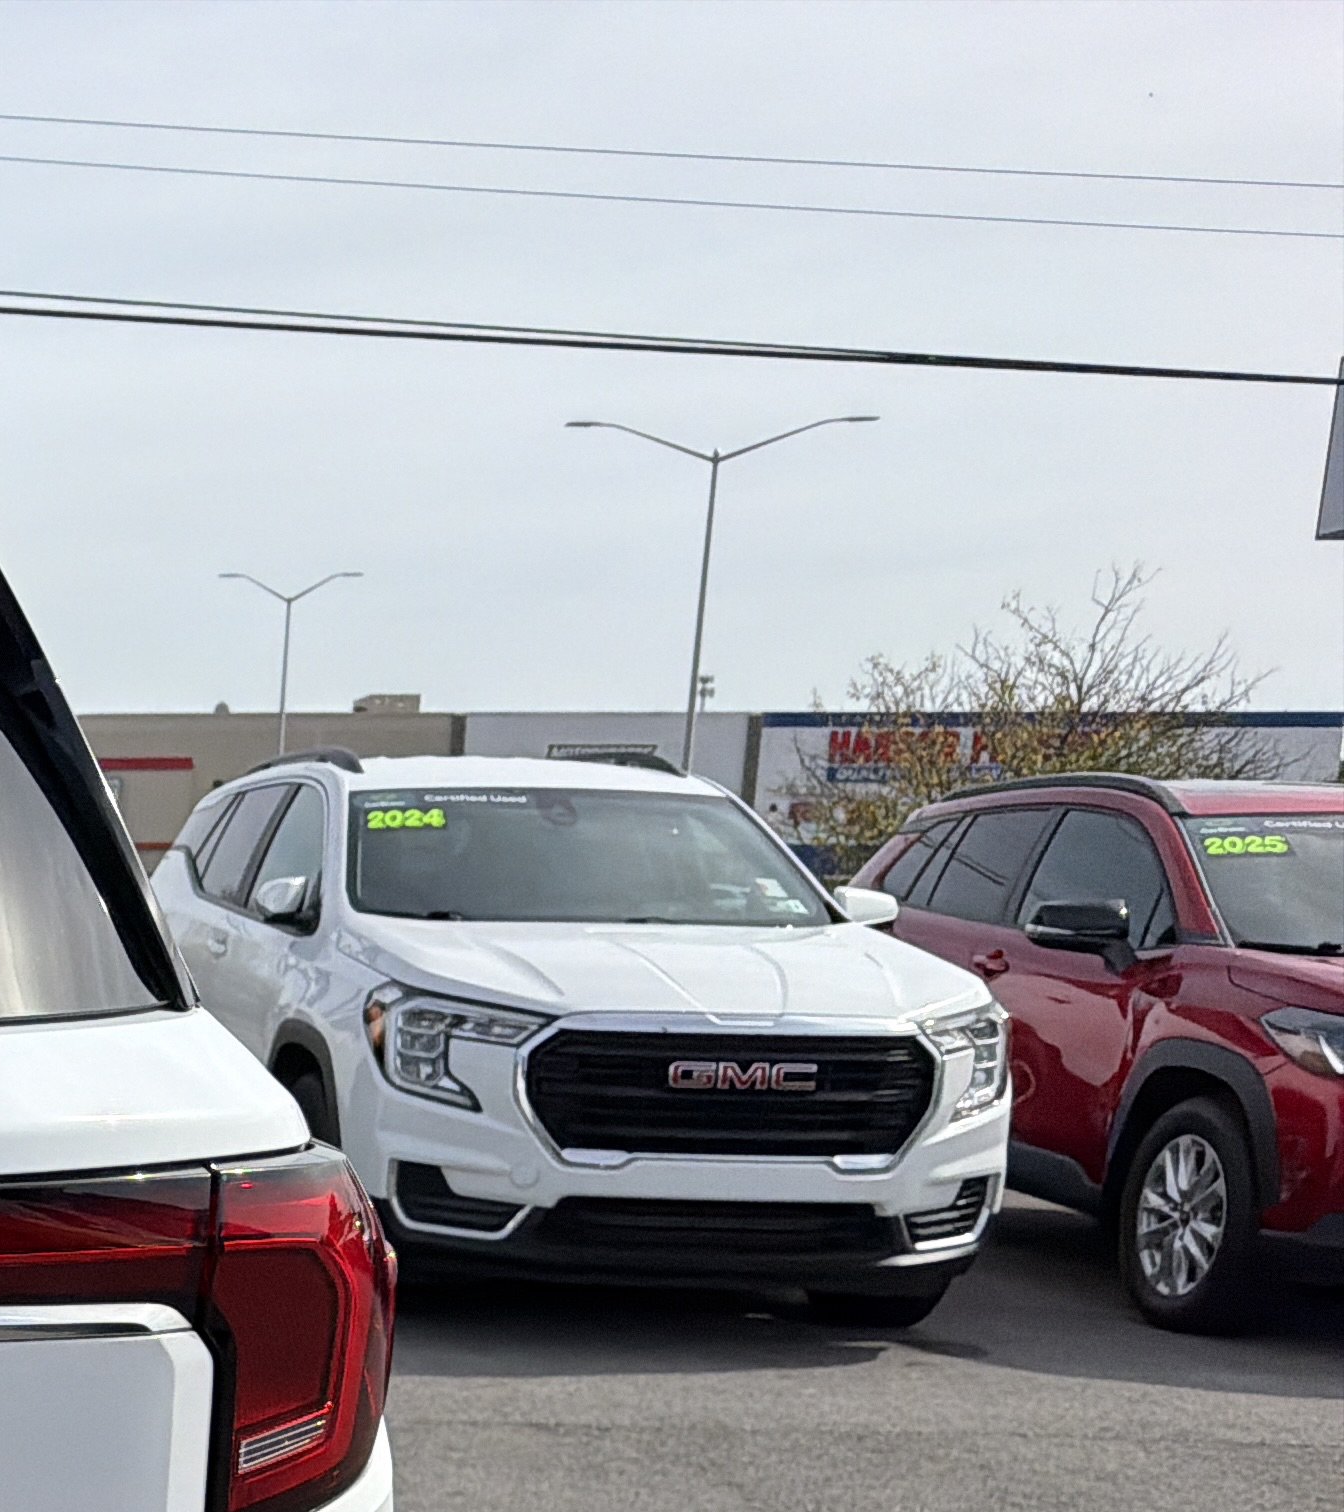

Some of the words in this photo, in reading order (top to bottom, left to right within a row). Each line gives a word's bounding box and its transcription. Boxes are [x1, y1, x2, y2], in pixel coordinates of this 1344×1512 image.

[367, 808, 445, 829] 2024
[1204, 835, 1288, 855] 2025
[668, 1061, 818, 1091] GMC
